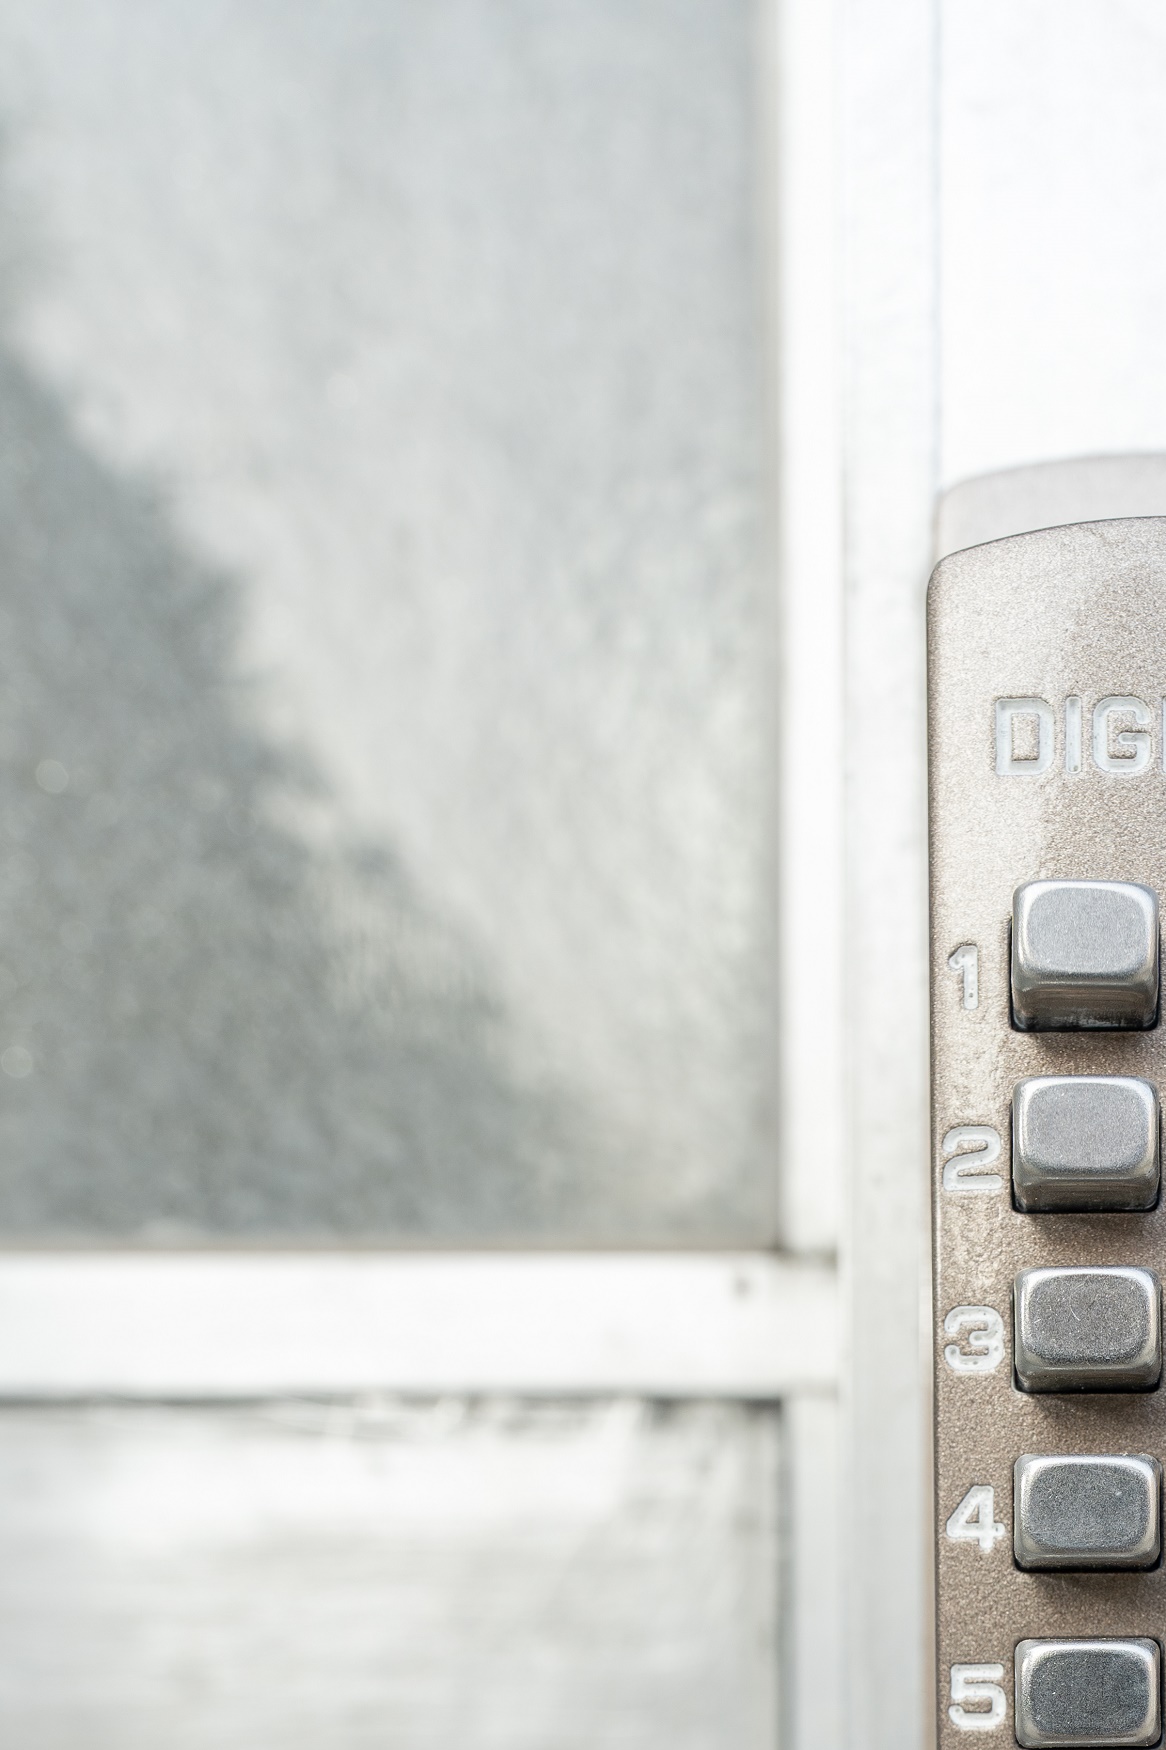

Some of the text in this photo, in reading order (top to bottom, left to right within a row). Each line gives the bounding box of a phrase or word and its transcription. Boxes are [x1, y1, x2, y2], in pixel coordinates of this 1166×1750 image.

[948, 943, 979, 1010] 1
[943, 1125, 1001, 1191] 2
[944, 1305, 1005, 1373] 3
[945, 1485, 1005, 1552] 4
[948, 1663, 1007, 1731] 5
